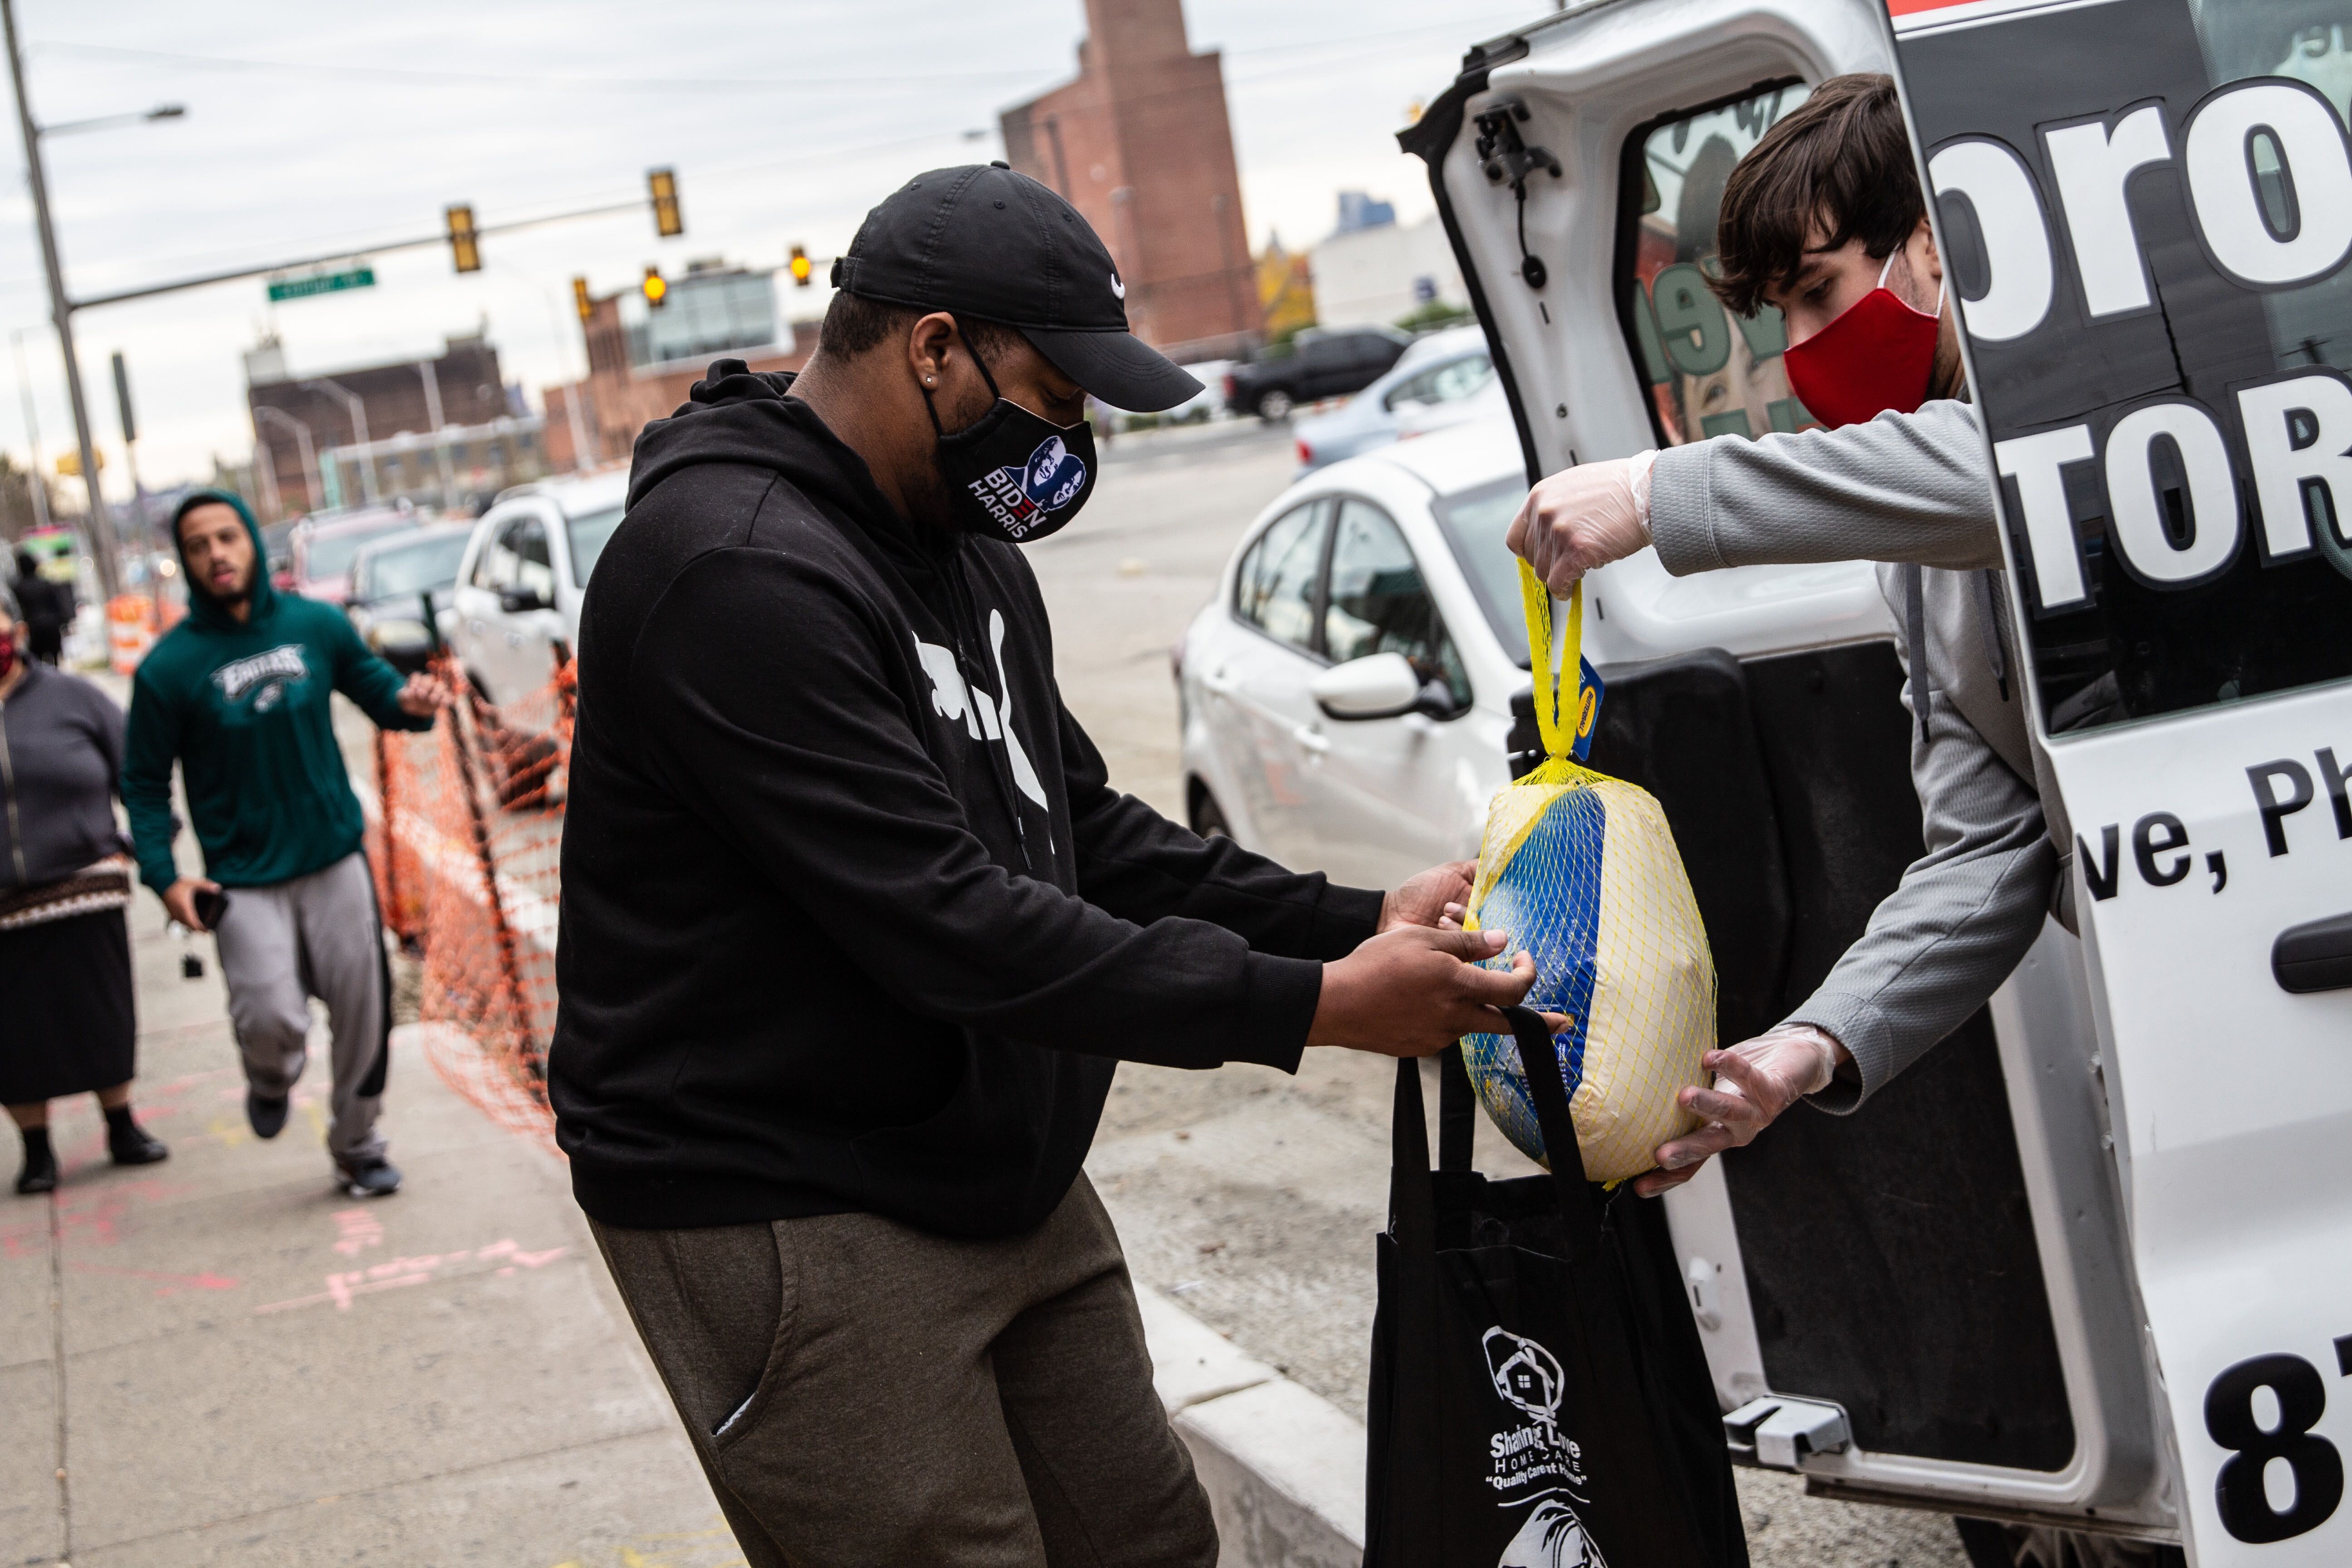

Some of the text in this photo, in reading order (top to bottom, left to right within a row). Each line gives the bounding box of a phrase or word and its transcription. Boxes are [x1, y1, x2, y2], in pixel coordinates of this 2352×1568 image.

[967, 480, 1028, 538] HARRIS
[984, 468, 1047, 528] BIDEN
[1994, 375, 2352, 609] TOR
[1579, 691, 1593, 732] BUTTERBALL
[1495, 1451, 1534, 1473] HOME
[2204, 1333, 2352, 1544] 8
[1527, 1465, 1546, 1479] Care
